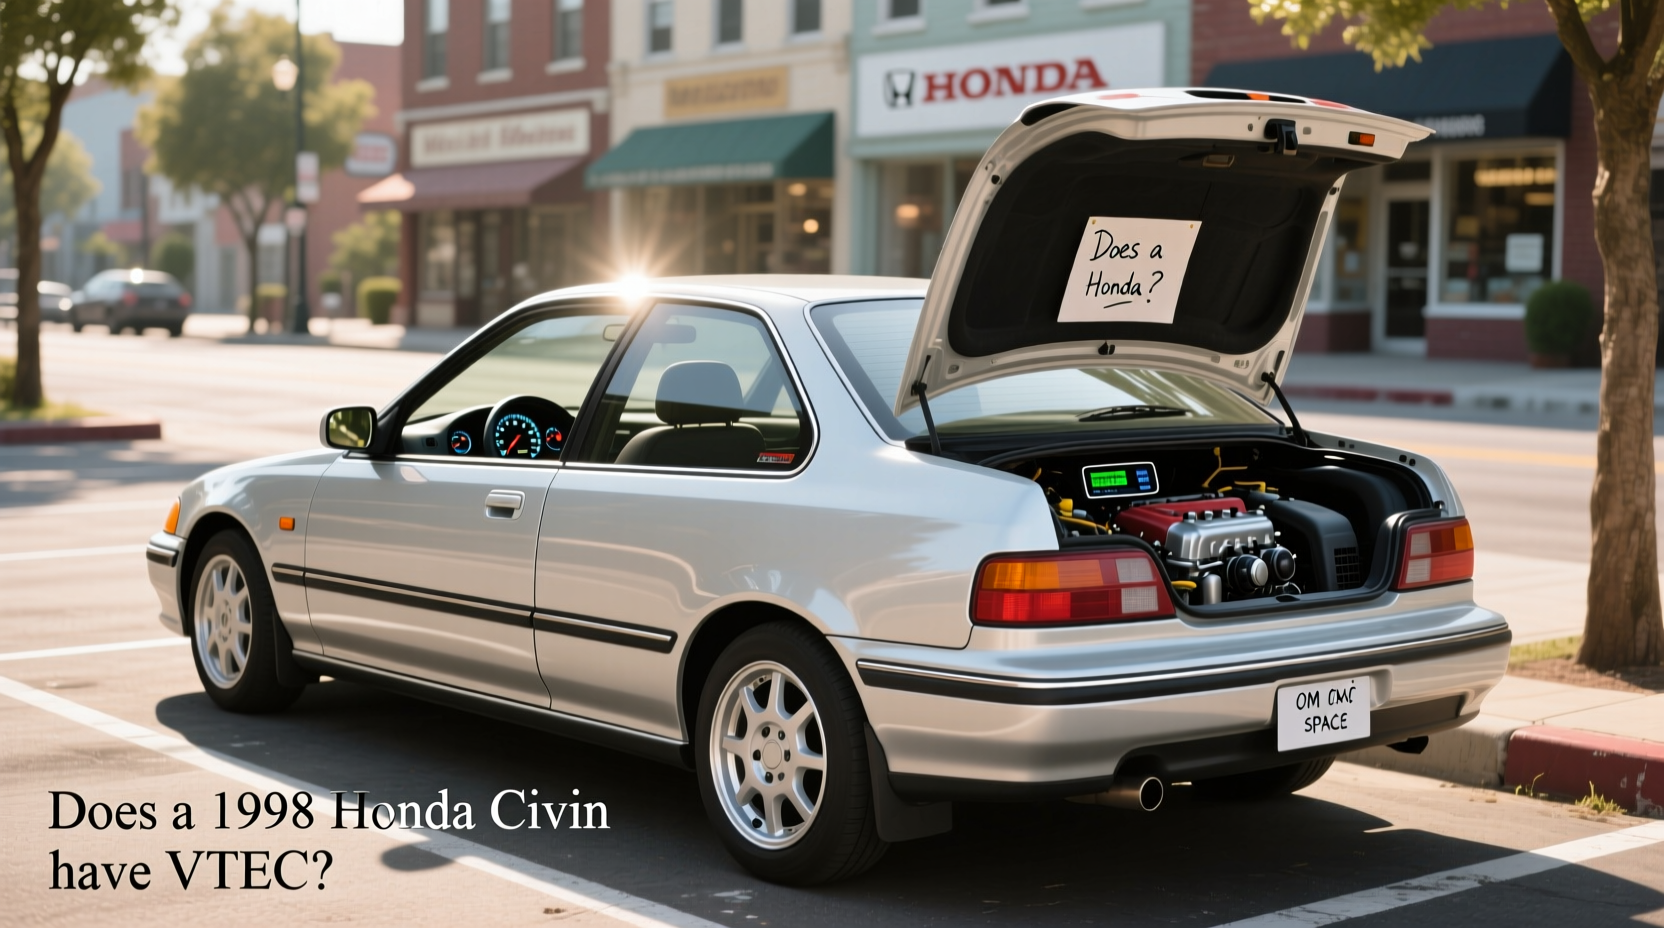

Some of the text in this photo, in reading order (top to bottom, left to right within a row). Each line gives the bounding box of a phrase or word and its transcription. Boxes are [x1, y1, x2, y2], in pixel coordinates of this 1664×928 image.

[922, 56, 1109, 104] HONDA
[1089, 229, 1163, 261] Does a
[1296, 690, 1320, 710] OM
[1304, 712, 1348, 734] SPACE
